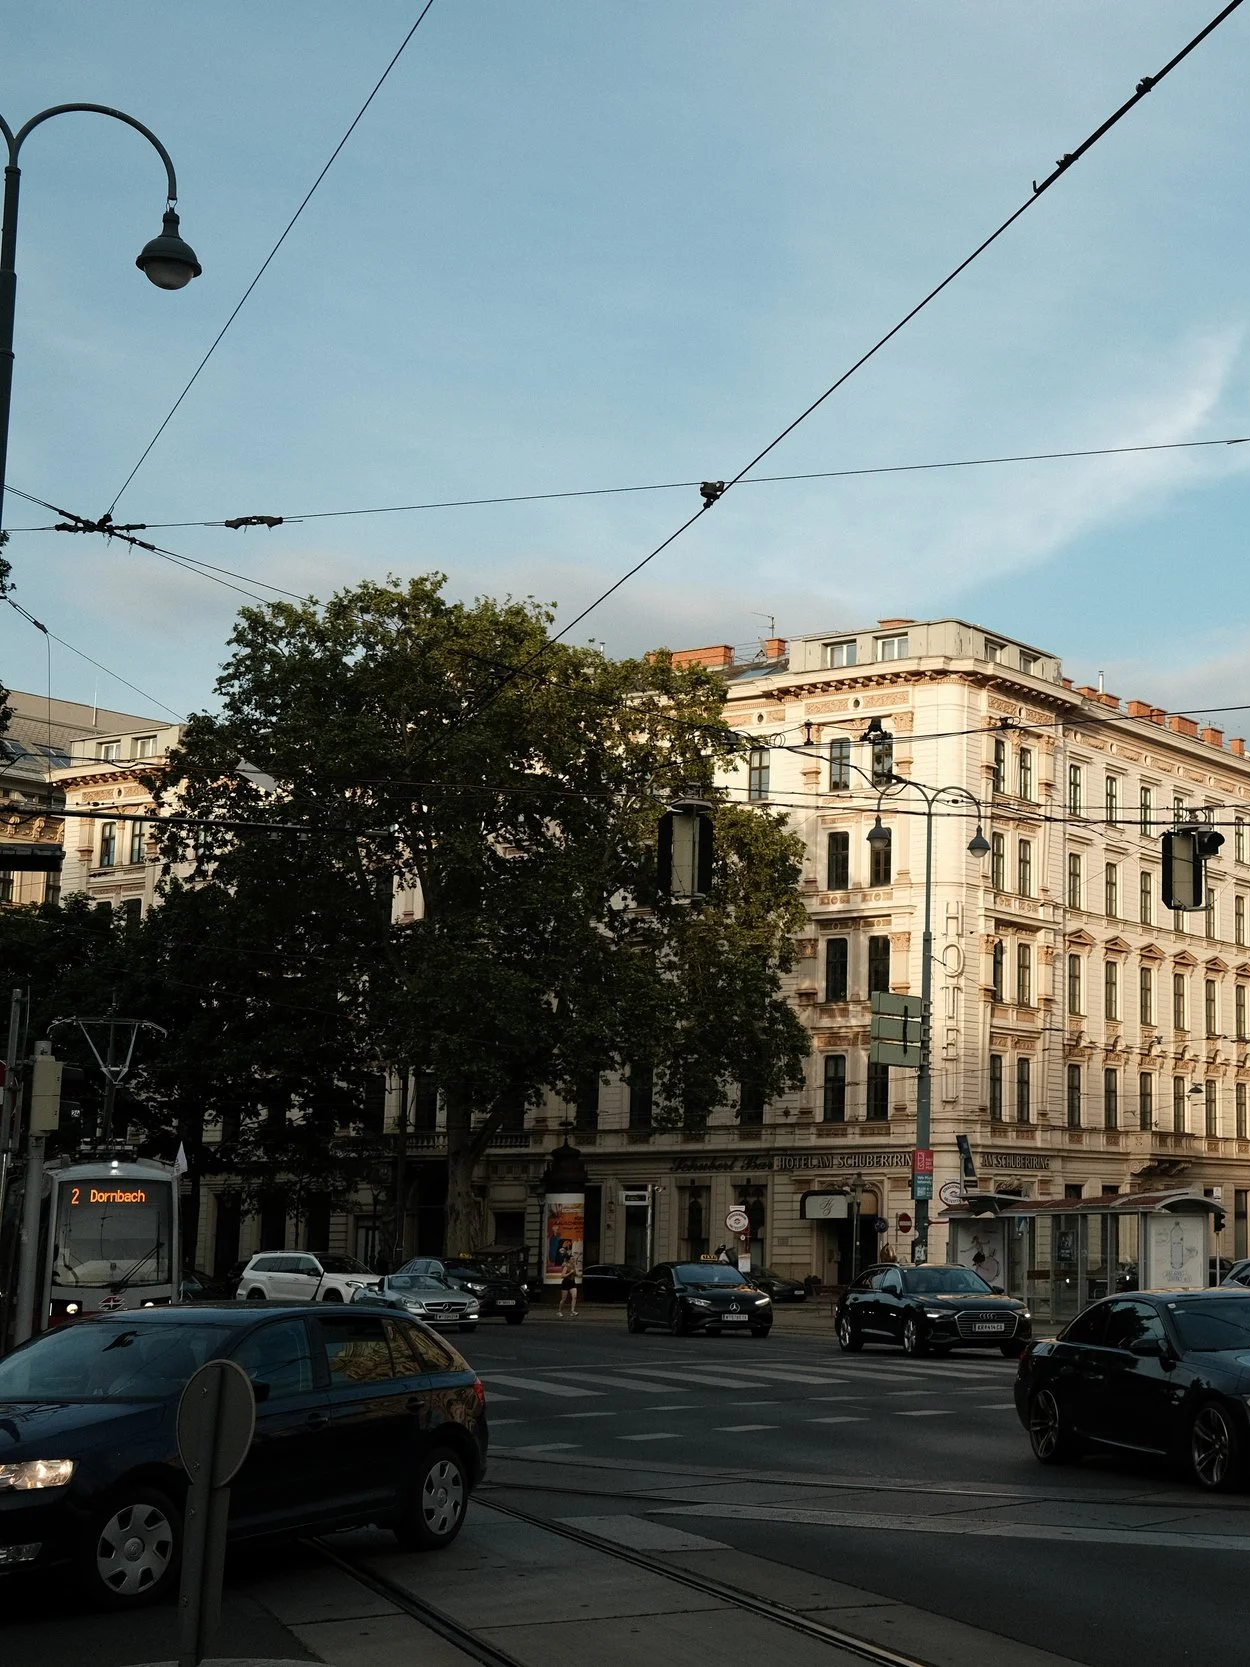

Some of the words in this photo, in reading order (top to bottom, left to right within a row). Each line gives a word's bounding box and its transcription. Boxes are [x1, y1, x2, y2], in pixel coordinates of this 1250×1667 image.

[779, 1155, 815, 1169] HOTEL
[818, 1155, 834, 1169] AM
[837, 1153, 913, 1168] SCHUBERTRIN
[71, 1187, 80, 1204] 2
[90, 1189, 146, 1203] Dornbach
